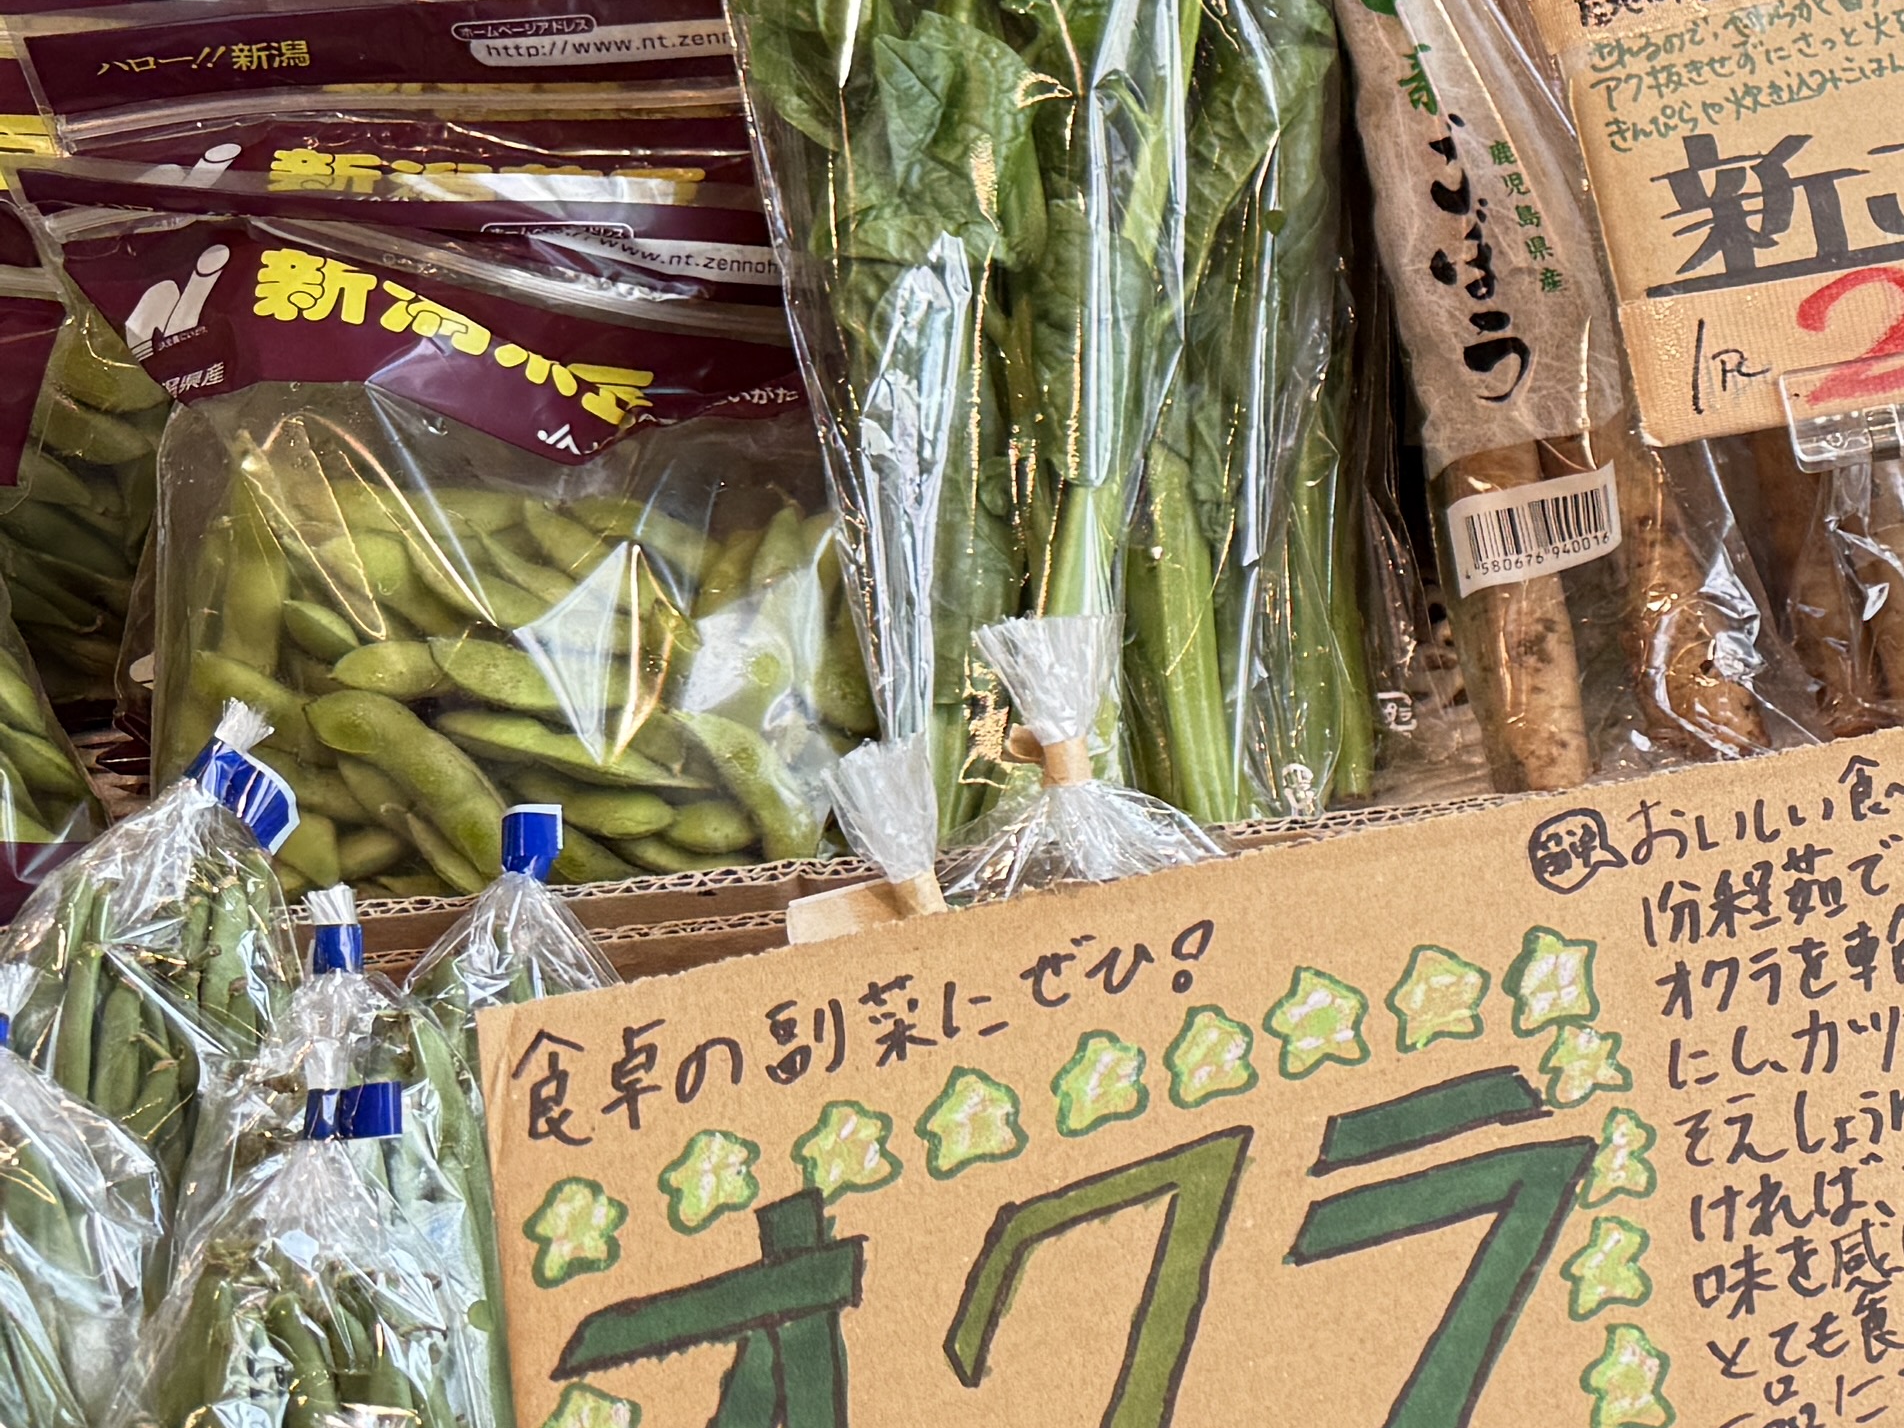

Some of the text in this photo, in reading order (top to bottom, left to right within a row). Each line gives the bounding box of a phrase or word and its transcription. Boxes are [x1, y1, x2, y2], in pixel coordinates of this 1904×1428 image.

[1488, 139, 1564, 294] 鹿児島県産
[1481, 553, 1545, 576] 580676
[1552, 533, 1611, 559] 940016
